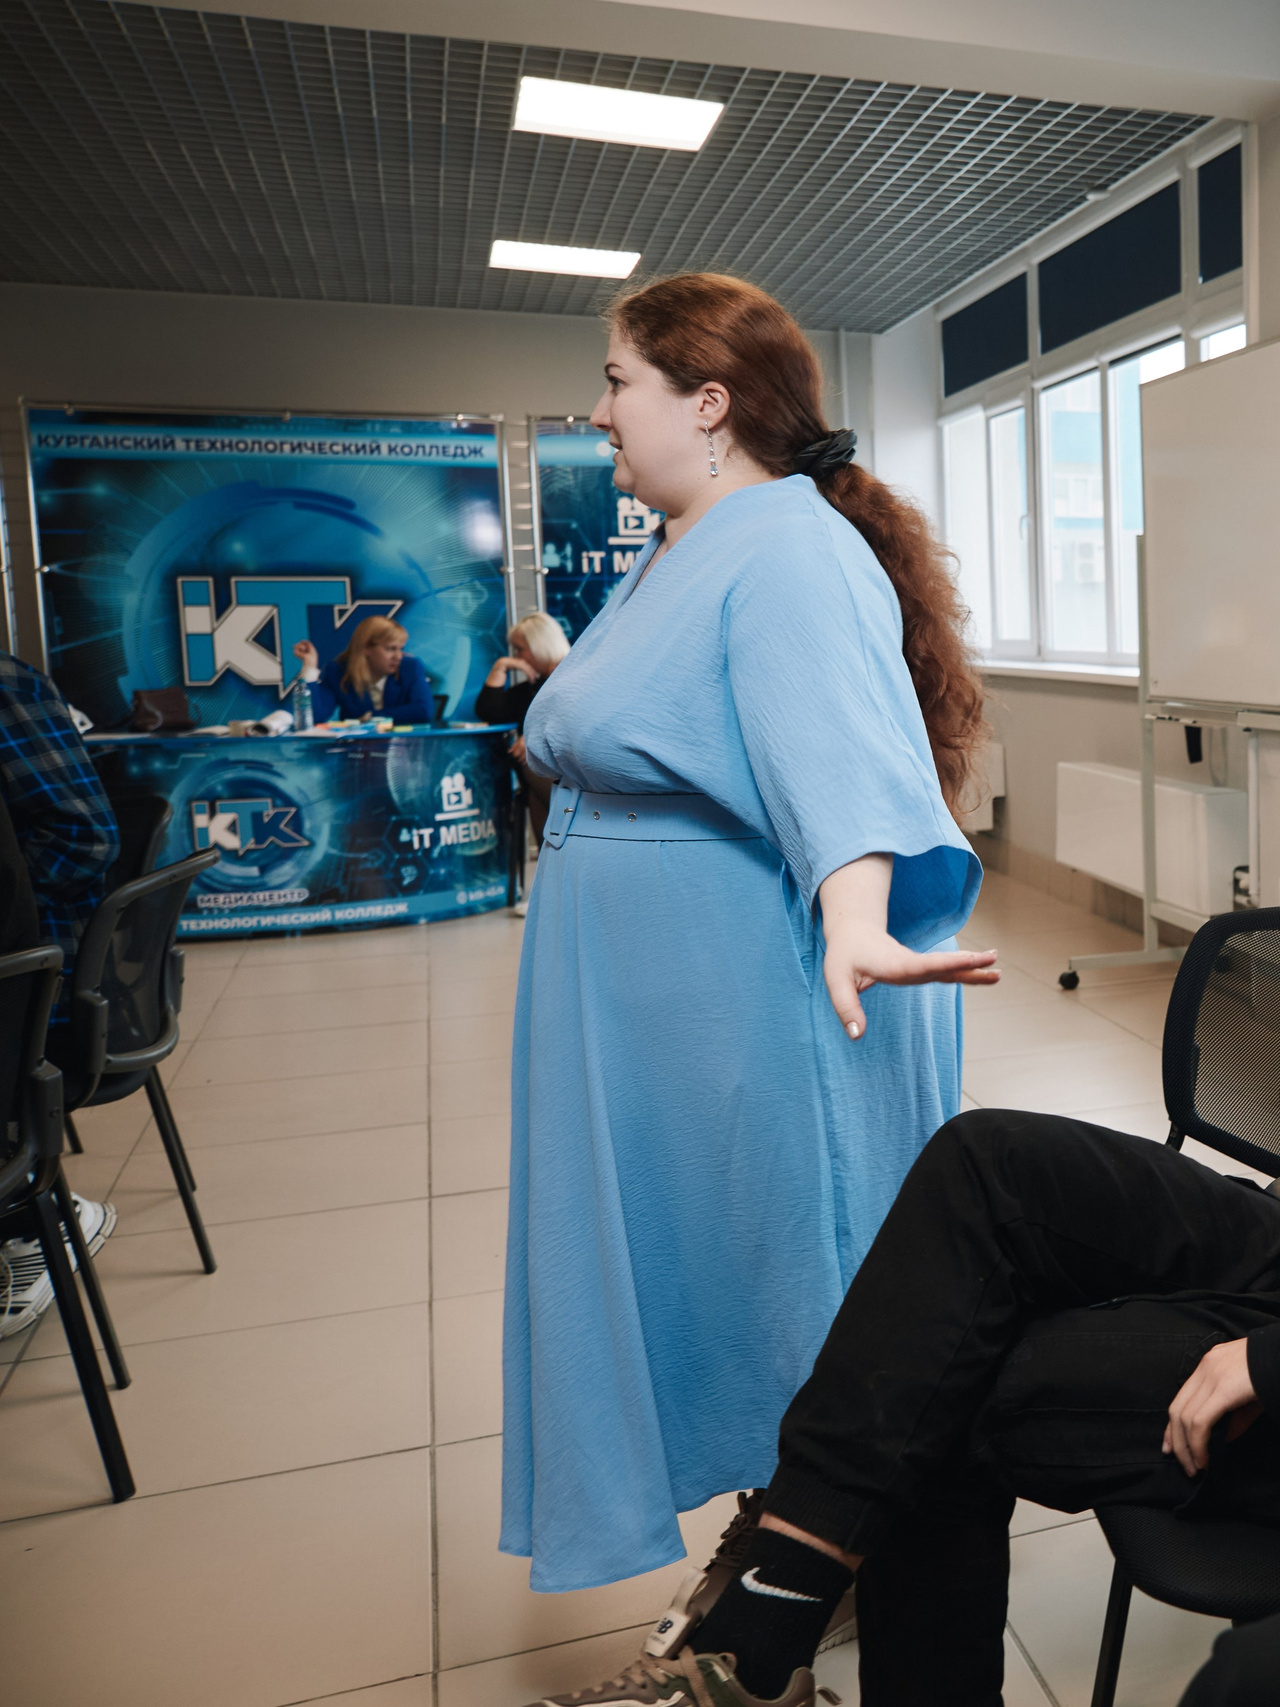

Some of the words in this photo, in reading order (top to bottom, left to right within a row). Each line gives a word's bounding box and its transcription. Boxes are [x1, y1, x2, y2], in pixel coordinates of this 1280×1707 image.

[37, 434, 176, 450] КУРГАНСКИЙ
[184, 438, 381, 455] ТЕХНОЛОГИЧЕСКИЙ
[387, 443, 484, 459] КОЛЛЕДЖ
[440, 819, 497, 847] MEDIA
[181, 908, 333, 931] ТЕХНОЛОГИЧЕСКИЙ
[335, 902, 409, 921] КОЛЛЕДЖ
